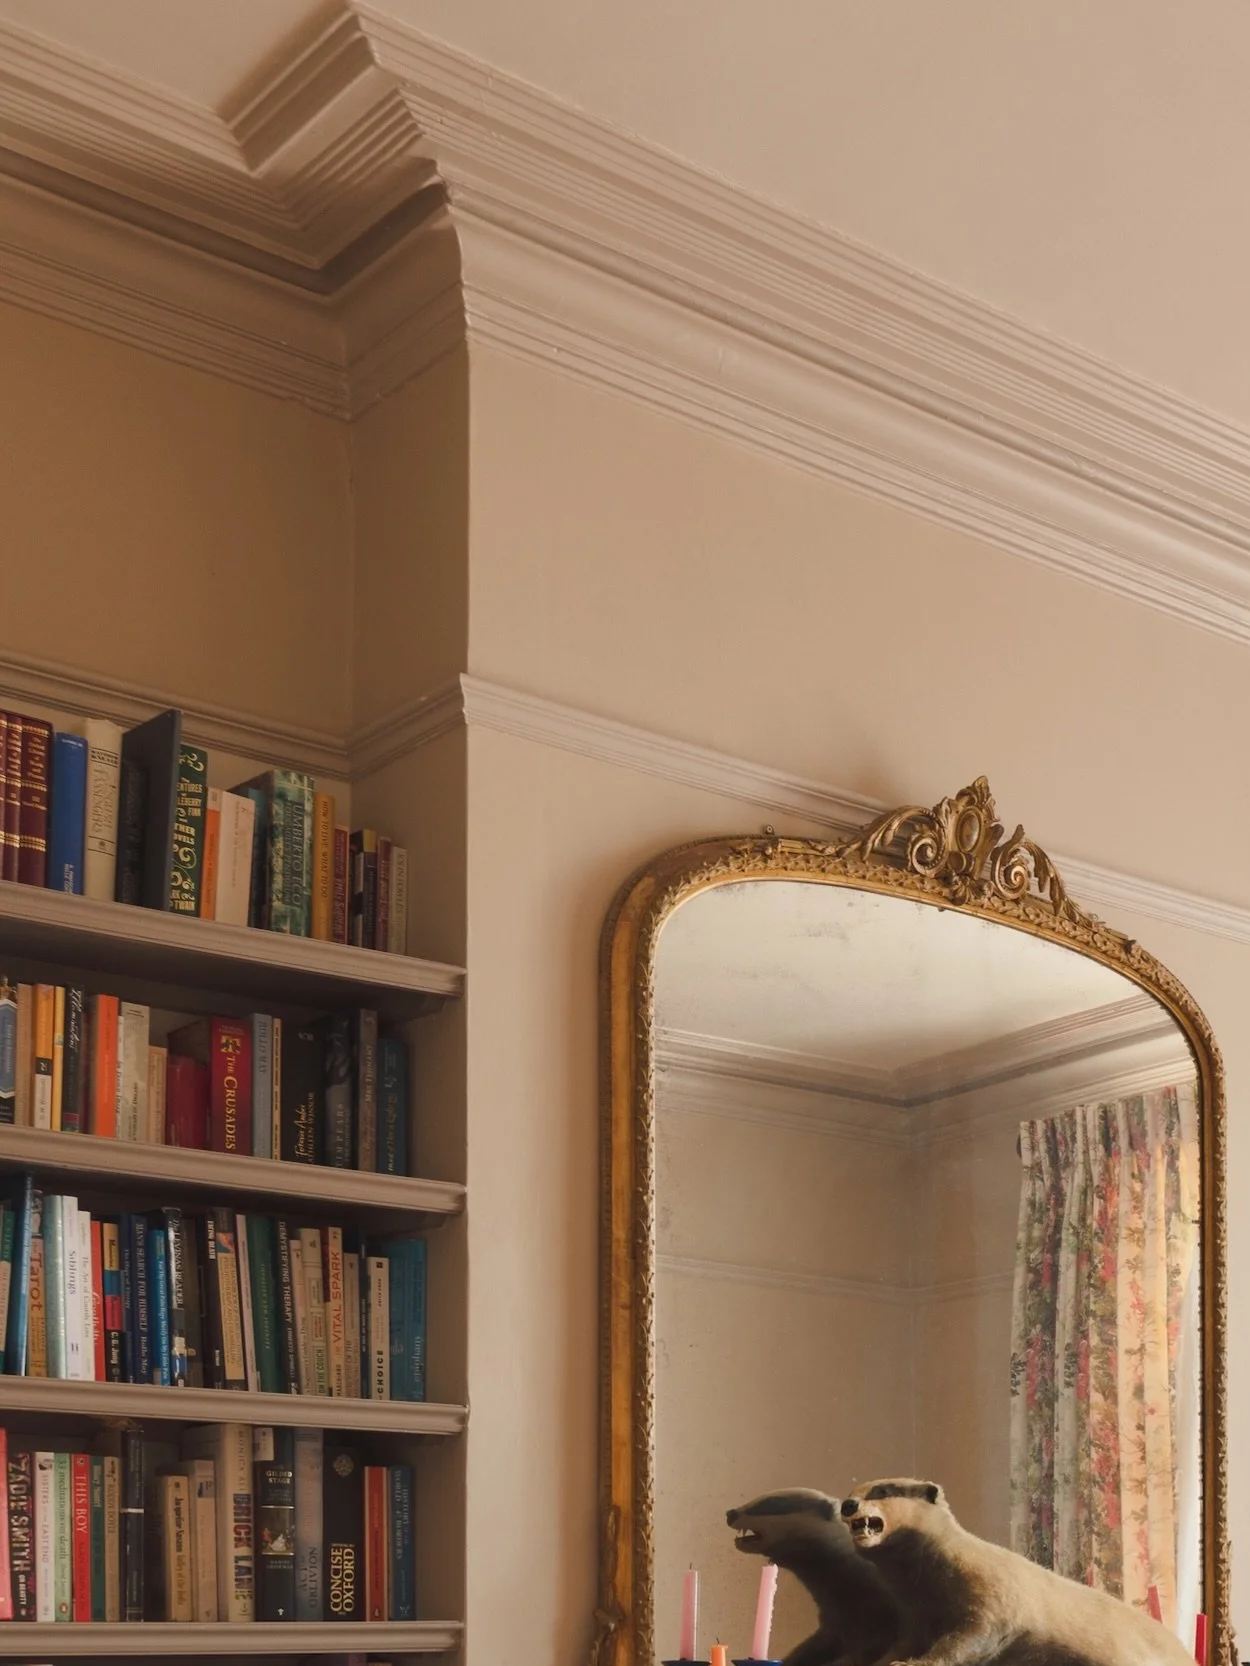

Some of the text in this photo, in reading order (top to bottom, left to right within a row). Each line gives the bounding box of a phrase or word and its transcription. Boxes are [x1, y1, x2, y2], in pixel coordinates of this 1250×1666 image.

[293, 804, 304, 906] UMBERTO ECO
[321, 801, 329, 898] HOW TO WHAT TO DO
[223, 1055, 238, 1151] THE CRUSADES
[30, 1252, 43, 1311] Tarot
[68, 1251, 78, 1296] Siblings
[279, 1222, 289, 1282] DEMYSTIFYING
[284, 1285, 293, 1323] THERAPY
[329, 1252, 342, 1344] VITAL SPARK
[375, 1348, 385, 1394] CHOICE
[7, 1462, 30, 1512] ZADIE
[75, 1474, 88, 1534] THIS BOY
[10, 1515, 32, 1572] SMITH
[59, 1535, 71, 1560] death
[233, 1493, 253, 1550] BRICK
[308, 1545, 318, 1608] OBLIVION
[330, 1547, 343, 1612] CONCISE
[343, 1548, 355, 1612] OXFORD
